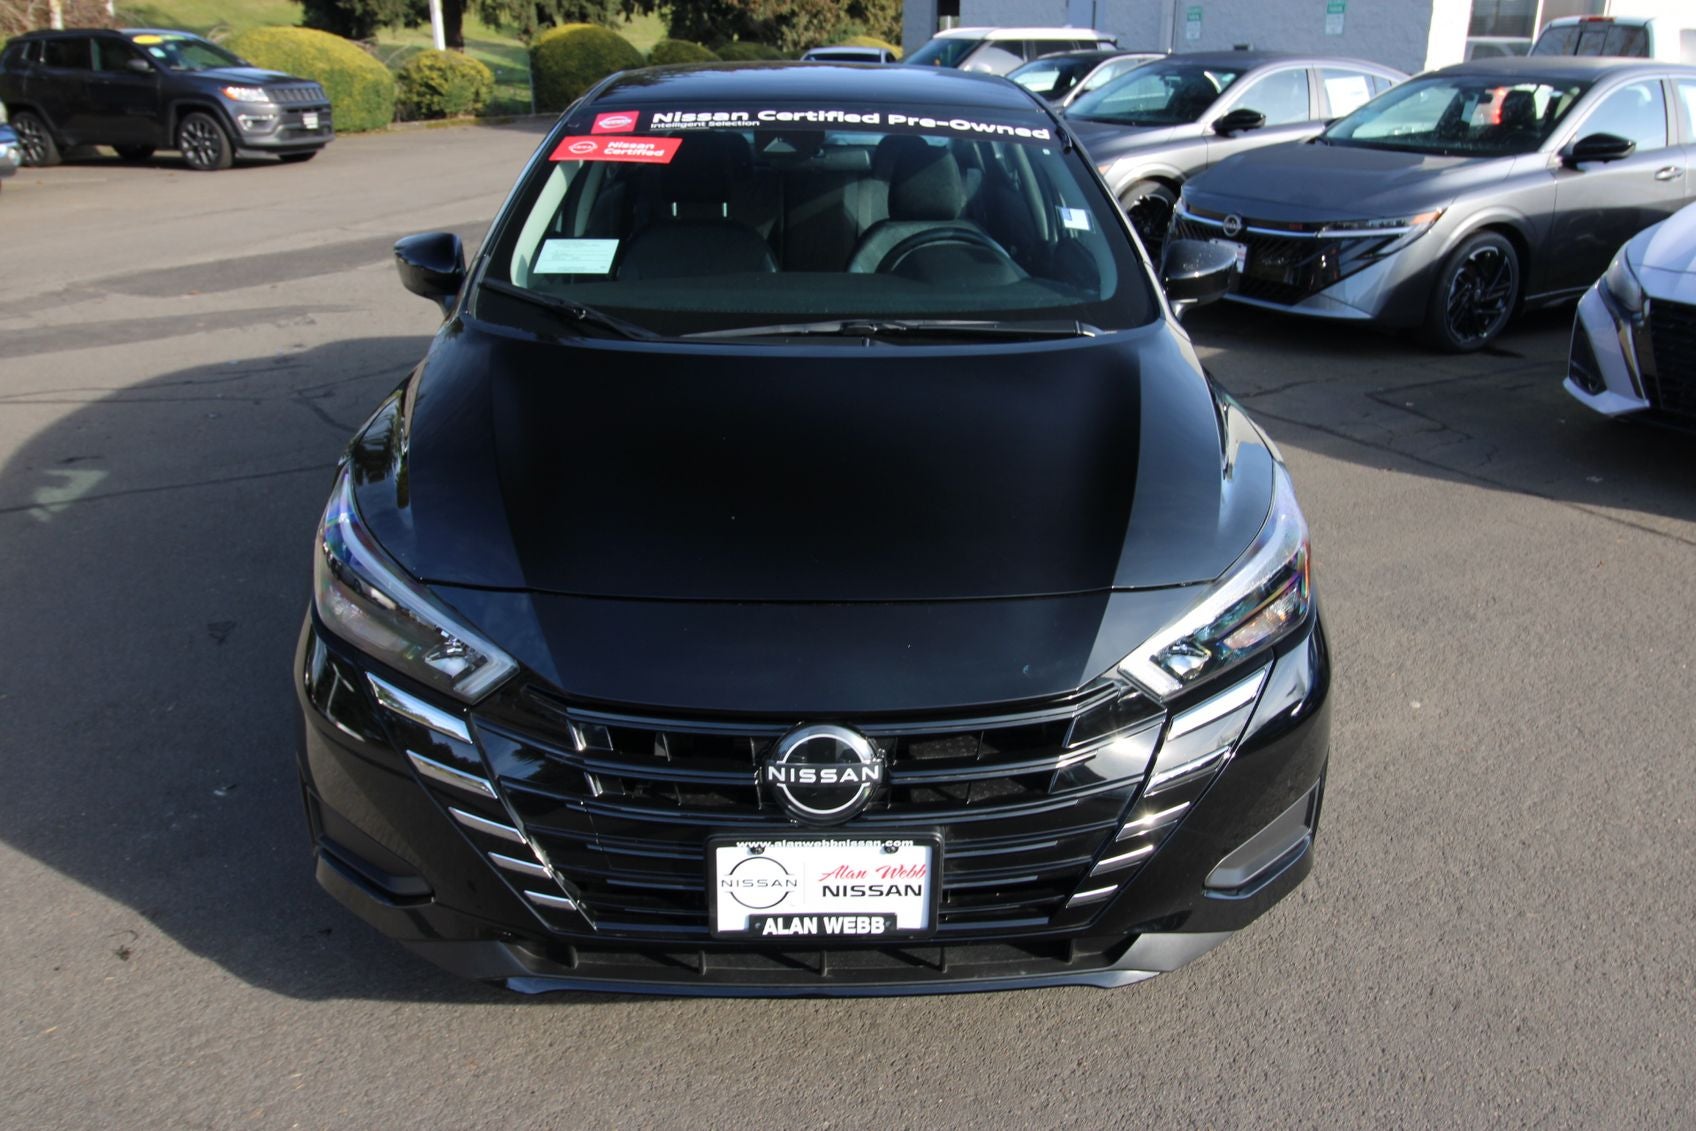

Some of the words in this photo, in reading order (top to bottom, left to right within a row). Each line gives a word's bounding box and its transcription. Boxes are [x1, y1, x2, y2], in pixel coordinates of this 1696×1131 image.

[650, 121, 706, 129] Intelligent
[652, 111, 749, 123] Nissan
[757, 110, 880, 124] Certified
[888, 114, 1050, 140] Pre-Owned
[607, 141, 655, 149] Nissan
[603, 148, 665, 157] Certified
[768, 765, 879, 784] NISSAN
[736, 839, 914, 848] www.alanwebbnissan.com
[818, 864, 870, 882] Alan
[875, 863, 927, 880] Webb
[721, 879, 798, 888] NISSAN
[822, 884, 923, 898] NISSAN
[762, 916, 818, 935] ALAN
[824, 916, 885, 934] WEBB
